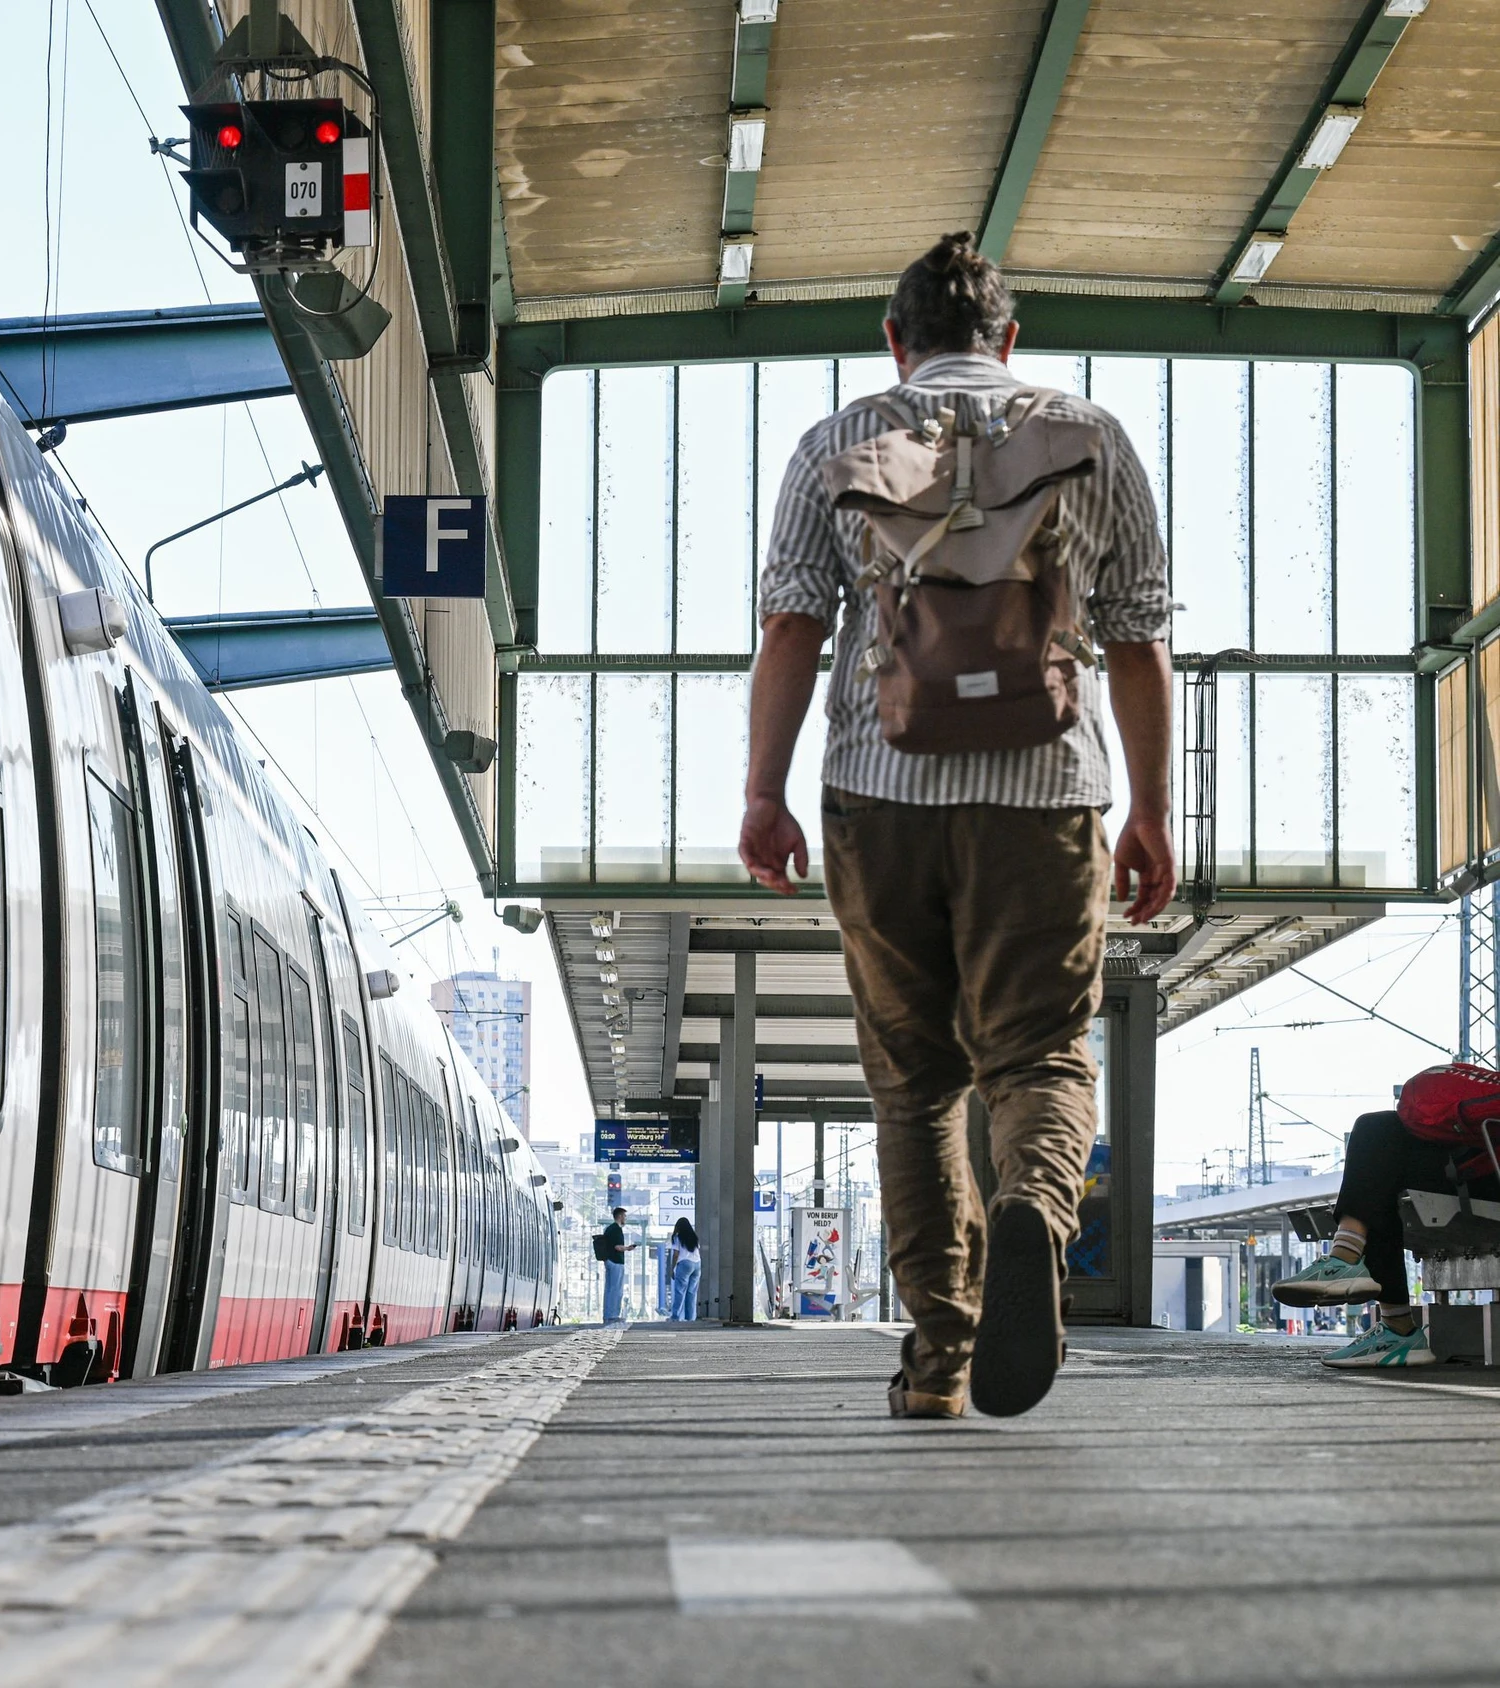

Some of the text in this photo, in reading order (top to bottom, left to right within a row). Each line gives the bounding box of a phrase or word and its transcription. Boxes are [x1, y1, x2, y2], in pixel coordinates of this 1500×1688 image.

[291, 181, 316, 199] 070
[426, 499, 472, 572] F
[626, 1132, 654, 1141] Würzburg
[806, 1211, 839, 1220] VON BERUF
